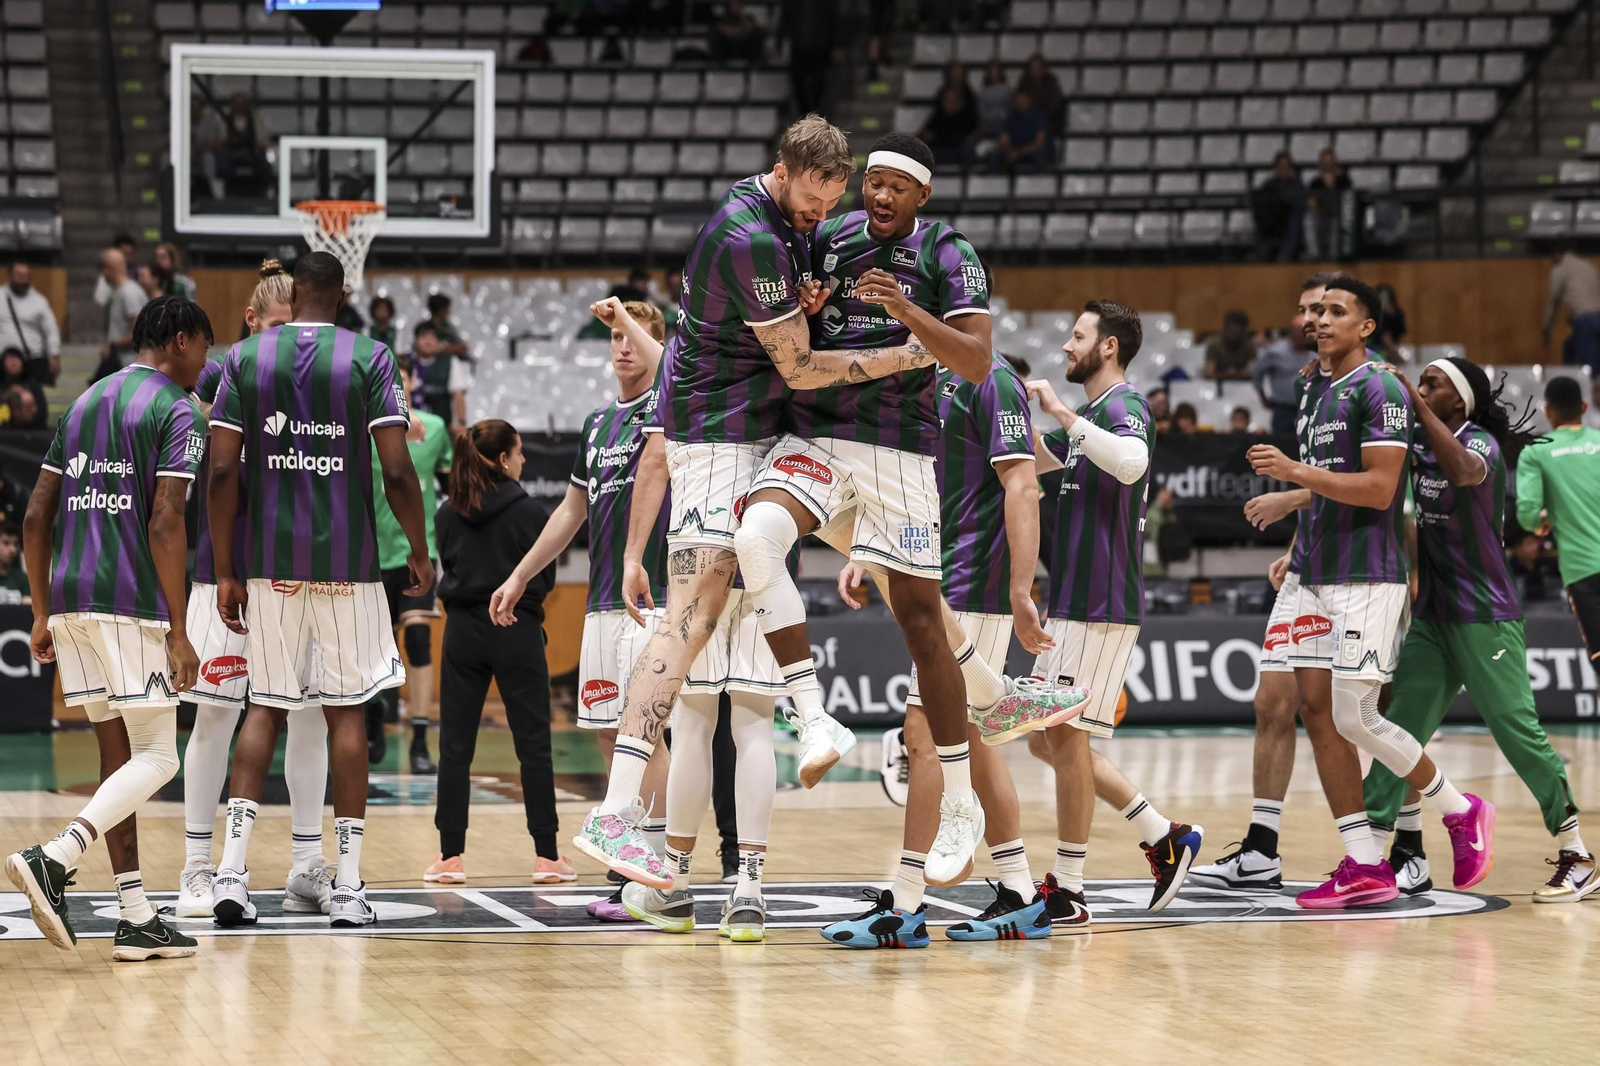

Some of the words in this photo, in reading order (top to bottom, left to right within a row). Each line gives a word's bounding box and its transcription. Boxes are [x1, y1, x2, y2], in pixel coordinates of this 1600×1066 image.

[758, 275, 788, 293] má
[754, 289, 788, 305] laga
[847, 315, 870, 324] COSTA
[870, 317, 885, 325] DEL
[885, 318, 901, 326] SOL
[847, 322, 876, 330] MÁLAGA
[1003, 410, 1027, 426] má
[1387, 404, 1408, 418] má
[289, 420, 346, 440] Unicaja
[998, 421, 1029, 439] laga
[1383, 413, 1408, 430] laga
[184, 440, 204, 462] lag
[89, 457, 135, 479] Unicaja
[267, 446, 344, 477] málaga
[774, 454, 832, 482] famadesa
[67, 485, 133, 516] málaga
[903, 521, 930, 538] má
[899, 533, 930, 553] laga
[309, 586, 356, 597] MÁLAGA
[231, 805, 245, 839] UNICAJA
[338, 824, 350, 855] UNICAJA
